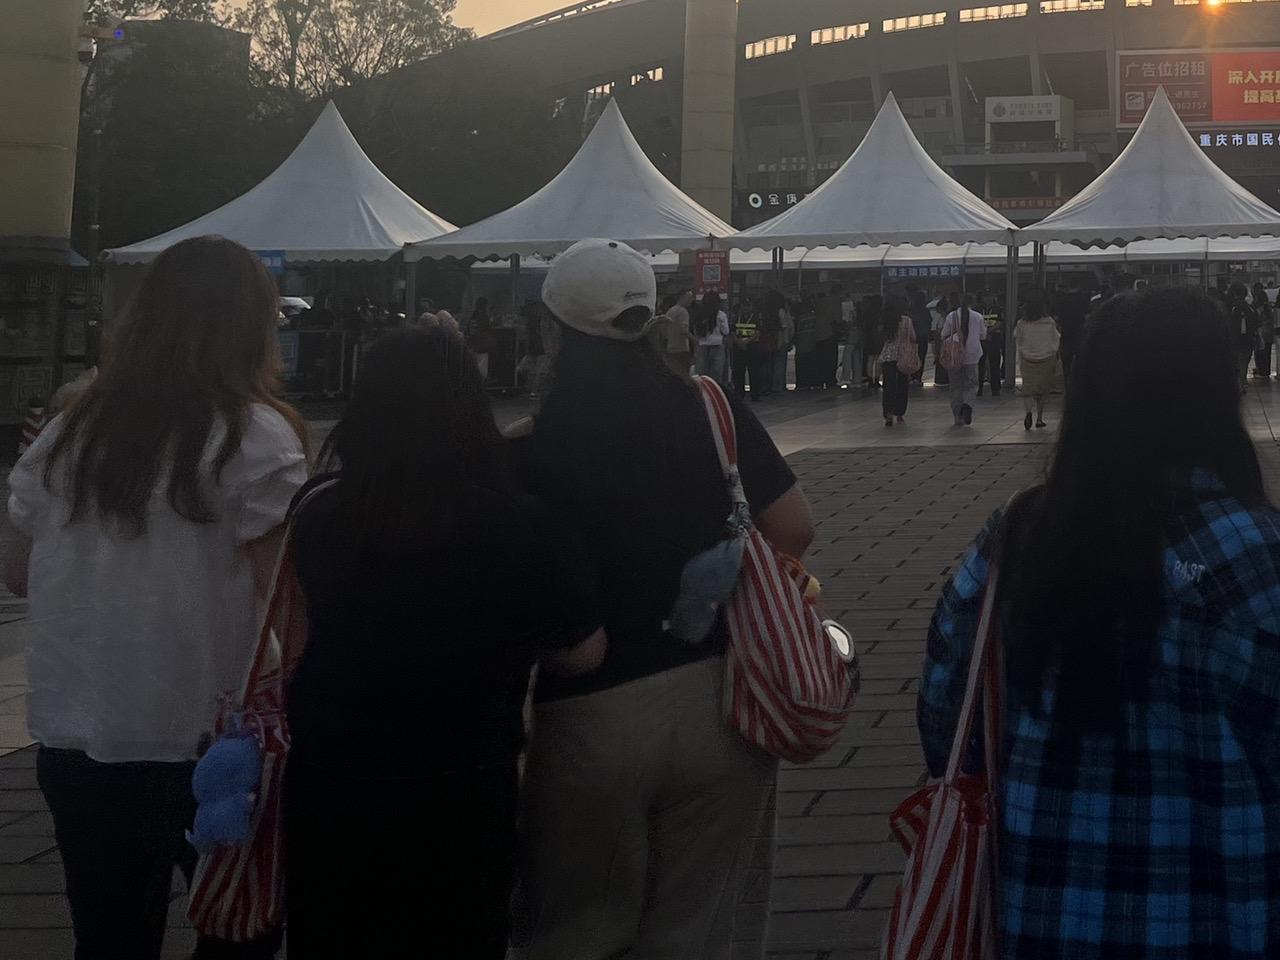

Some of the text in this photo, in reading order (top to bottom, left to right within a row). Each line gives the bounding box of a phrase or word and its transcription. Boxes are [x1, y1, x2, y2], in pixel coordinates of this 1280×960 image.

[1125, 61, 1206, 78] 广告位招租
